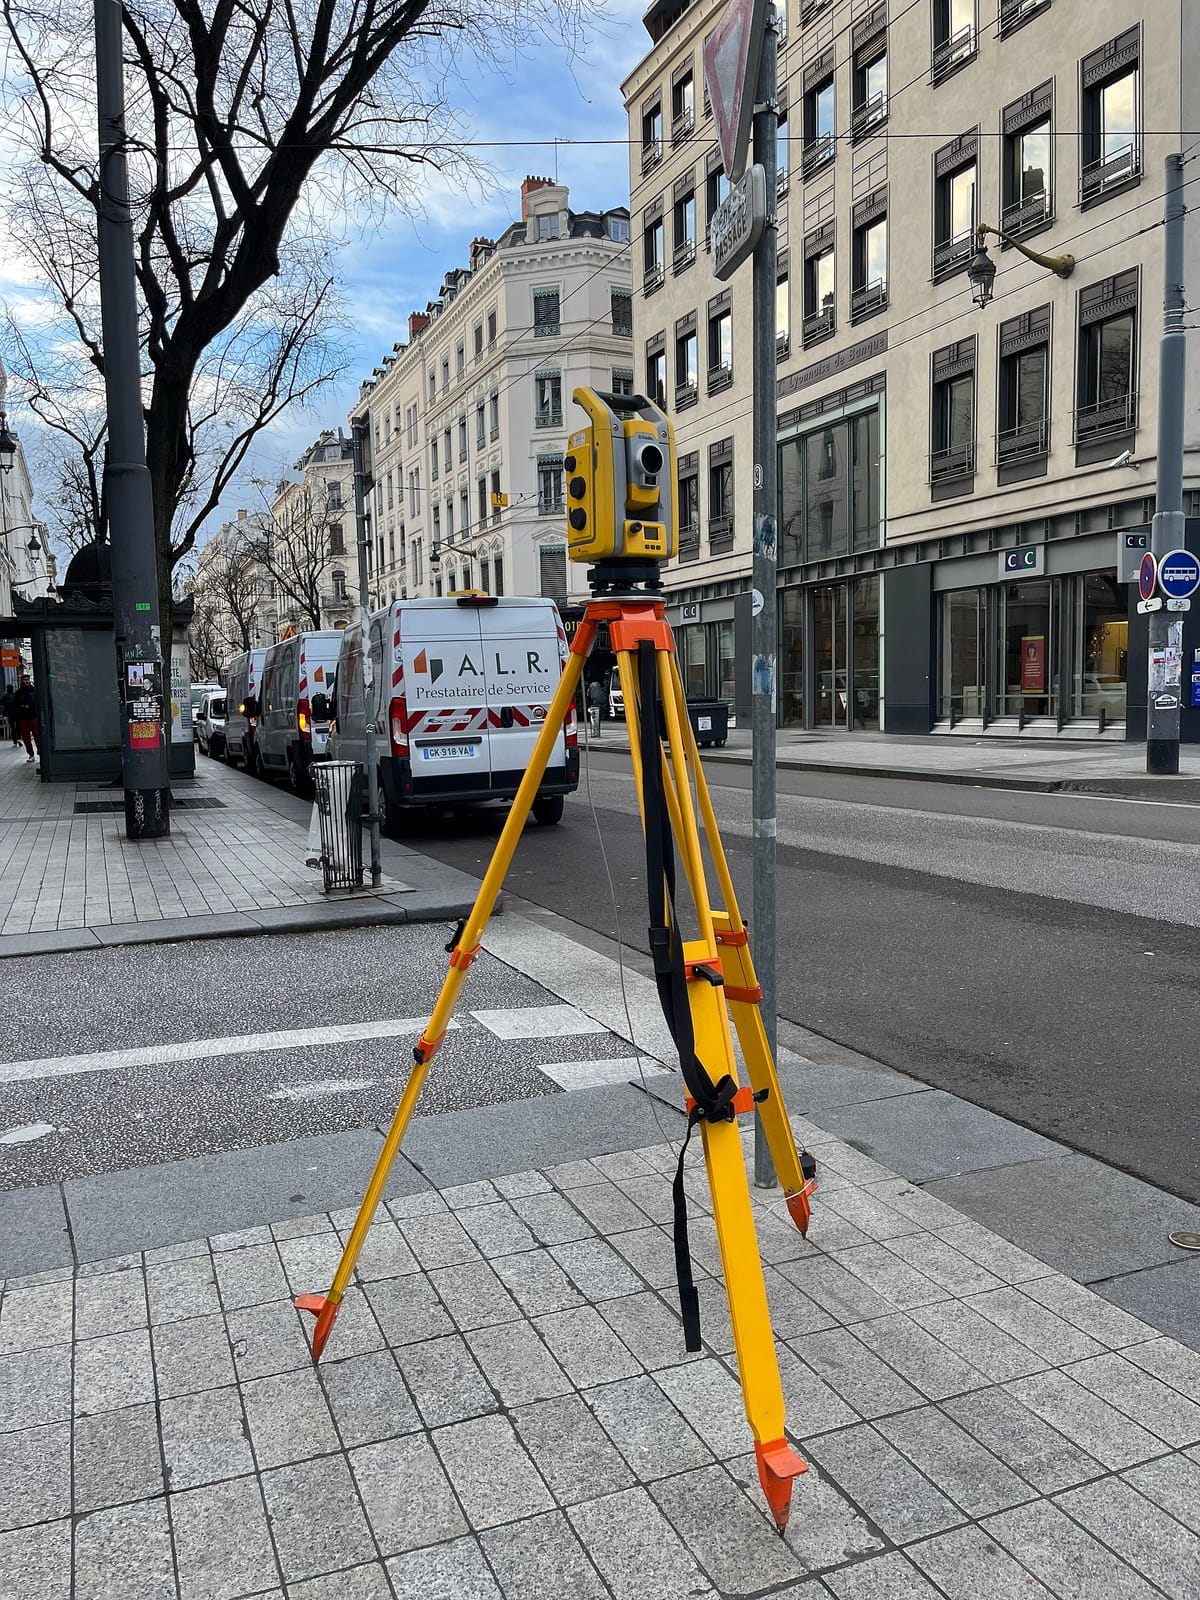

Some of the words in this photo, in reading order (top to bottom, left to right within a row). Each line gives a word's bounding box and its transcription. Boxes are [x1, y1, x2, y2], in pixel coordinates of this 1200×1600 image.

[716, 218, 747, 260] PASSAGE
[789, 363, 830, 389] Lyonnaise
[834, 353, 845, 367] de
[849, 338, 885, 361] Banque
[416, 685, 484, 699] Prestataire
[488, 685, 503, 696] de
[506, 683, 551, 695] Service
